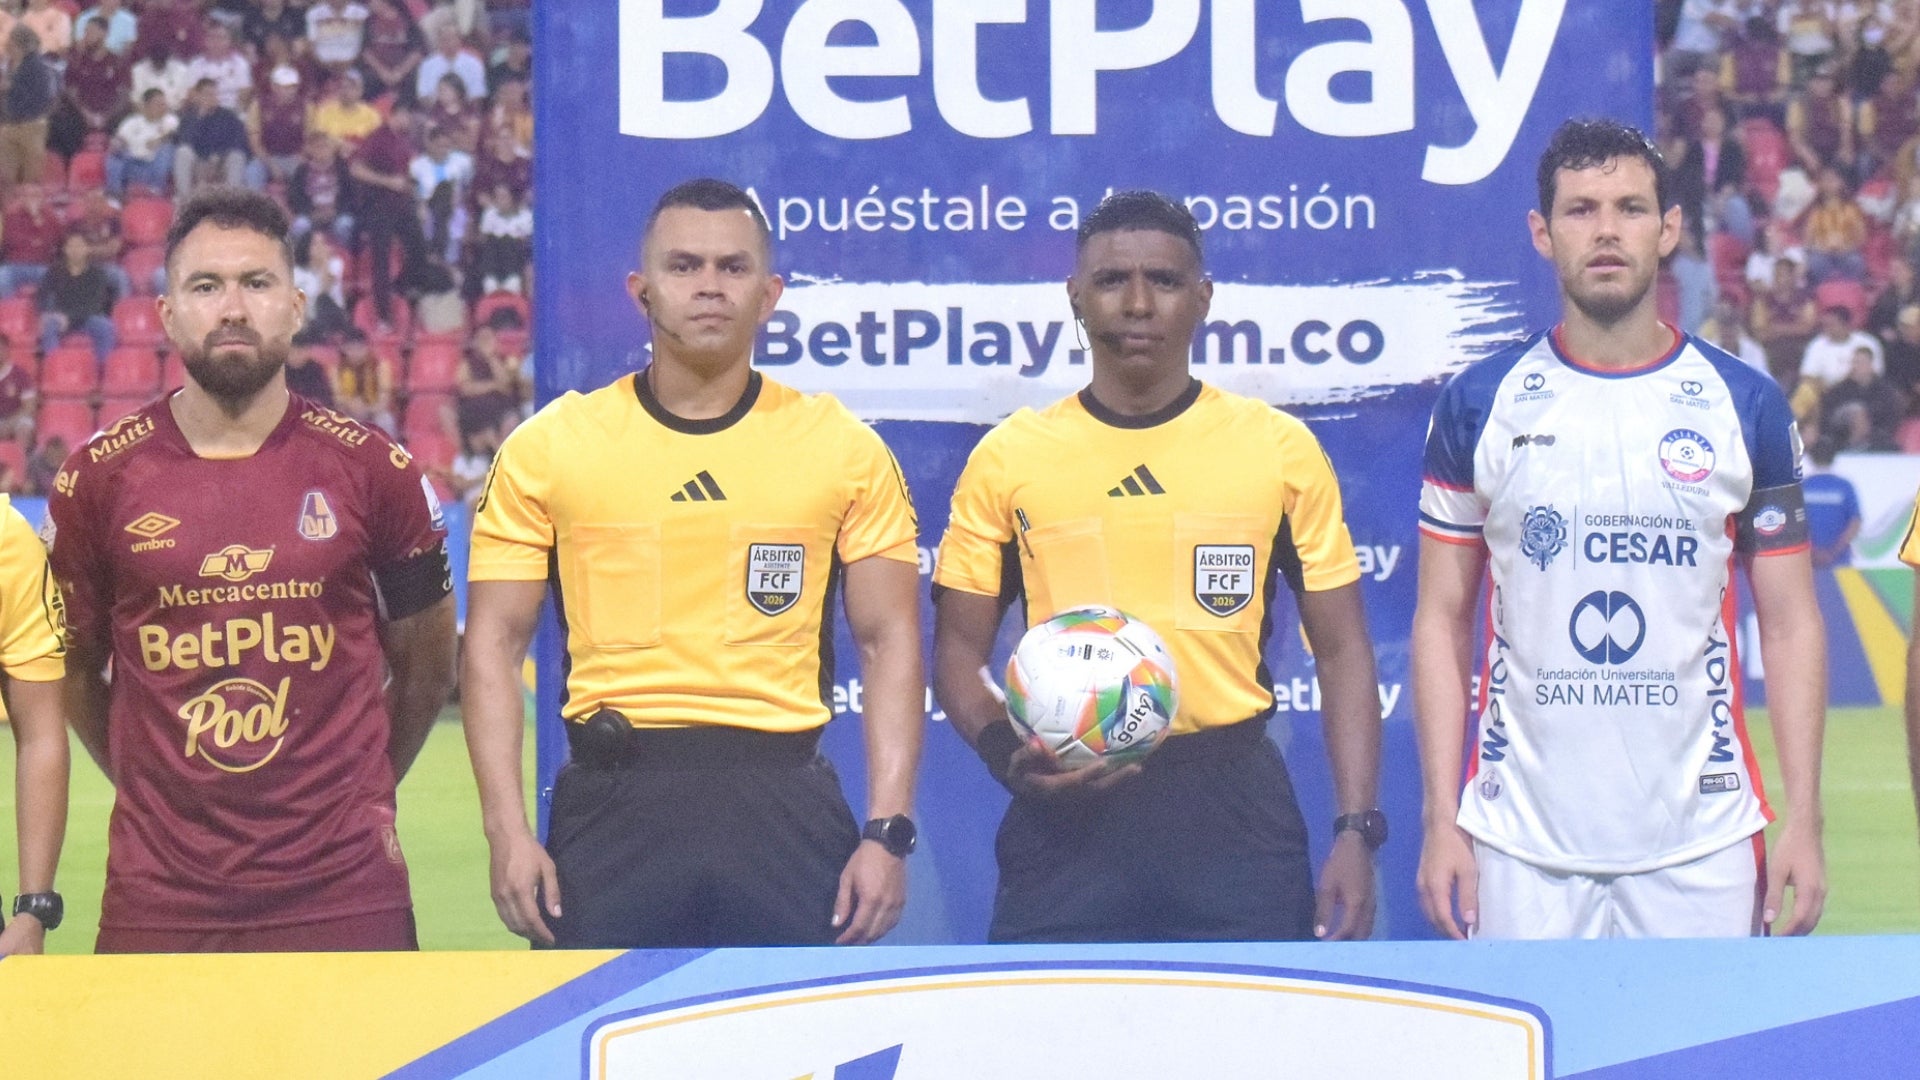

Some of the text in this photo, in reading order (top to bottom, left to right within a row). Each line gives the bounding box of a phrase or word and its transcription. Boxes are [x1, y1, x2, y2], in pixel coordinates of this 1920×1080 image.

[618, 0, 1567, 185] BetPlay
[1048, 196, 1079, 231] a
[89, 416, 155, 463] Multi
[301, 411, 370, 446] Multi
[1584, 514, 1672, 529] GOBERNACIÓN
[131, 538, 176, 553] umbro
[753, 546, 802, 562] ÁRBITRO
[1584, 532, 1699, 567] CESAR
[1199, 551, 1251, 566] ÁRBITRO
[760, 573, 791, 589] FCF
[1208, 574, 1240, 590] FCF
[158, 578, 324, 609] Mercacentro
[763, 595, 785, 605] 2026
[1212, 597, 1235, 607] 2026
[138, 611, 335, 671] BetPlay
[1536, 667, 1675, 682] Fundación Universitaria
[1535, 684, 1678, 706] SAN MATEO
[177, 676, 291, 758] Pool
[1117, 698, 1152, 744] golty
